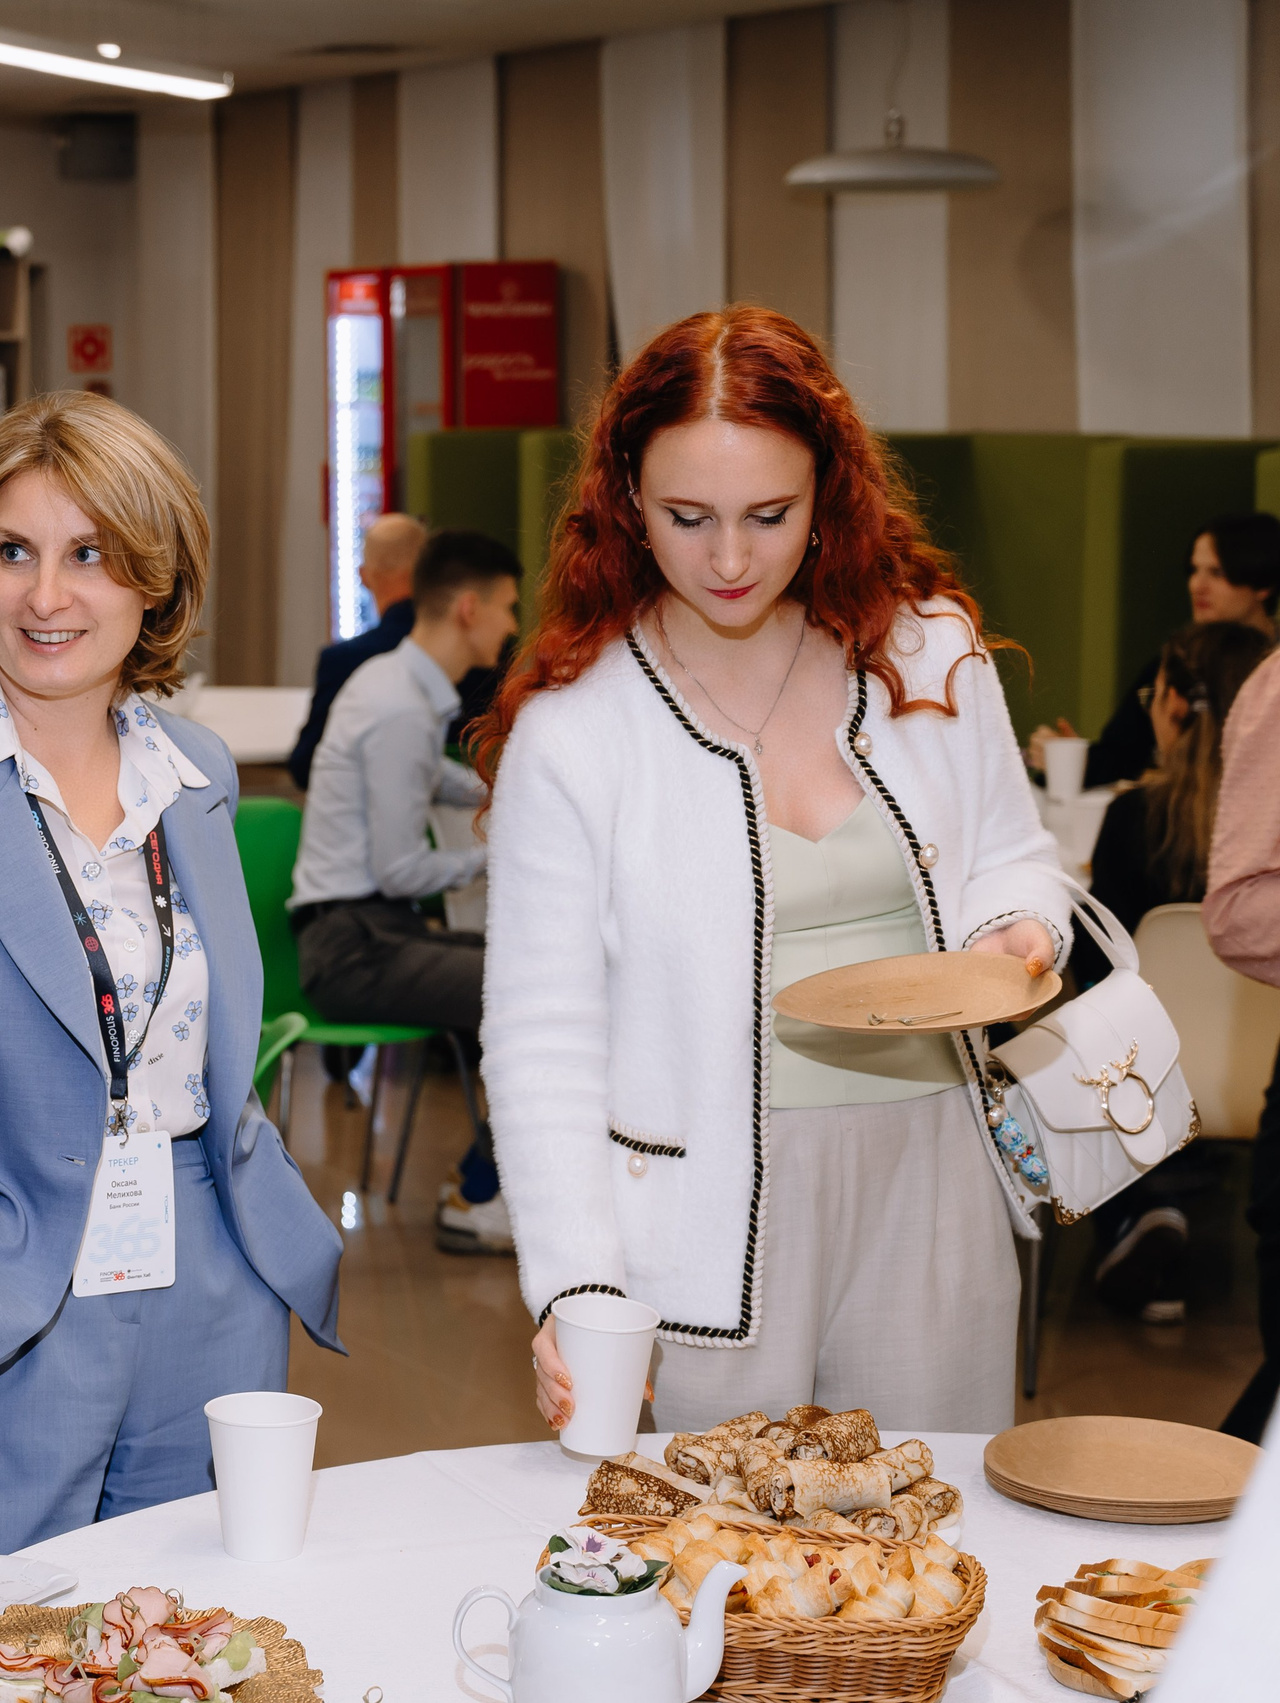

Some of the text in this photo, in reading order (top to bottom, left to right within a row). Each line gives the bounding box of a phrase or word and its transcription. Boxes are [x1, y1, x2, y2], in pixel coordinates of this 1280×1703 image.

[149, 830, 163, 886] СЕГОДНЯ
[100, 993, 121, 1063] FINOPOLIS 365
[108, 1156, 139, 1168] ТРЕКЕР
[111, 1179, 137, 1188] Оксана
[106, 1190, 143, 1200] Мелихова
[122, 1201, 140, 1209] России
[89, 1214, 161, 1264] 365
